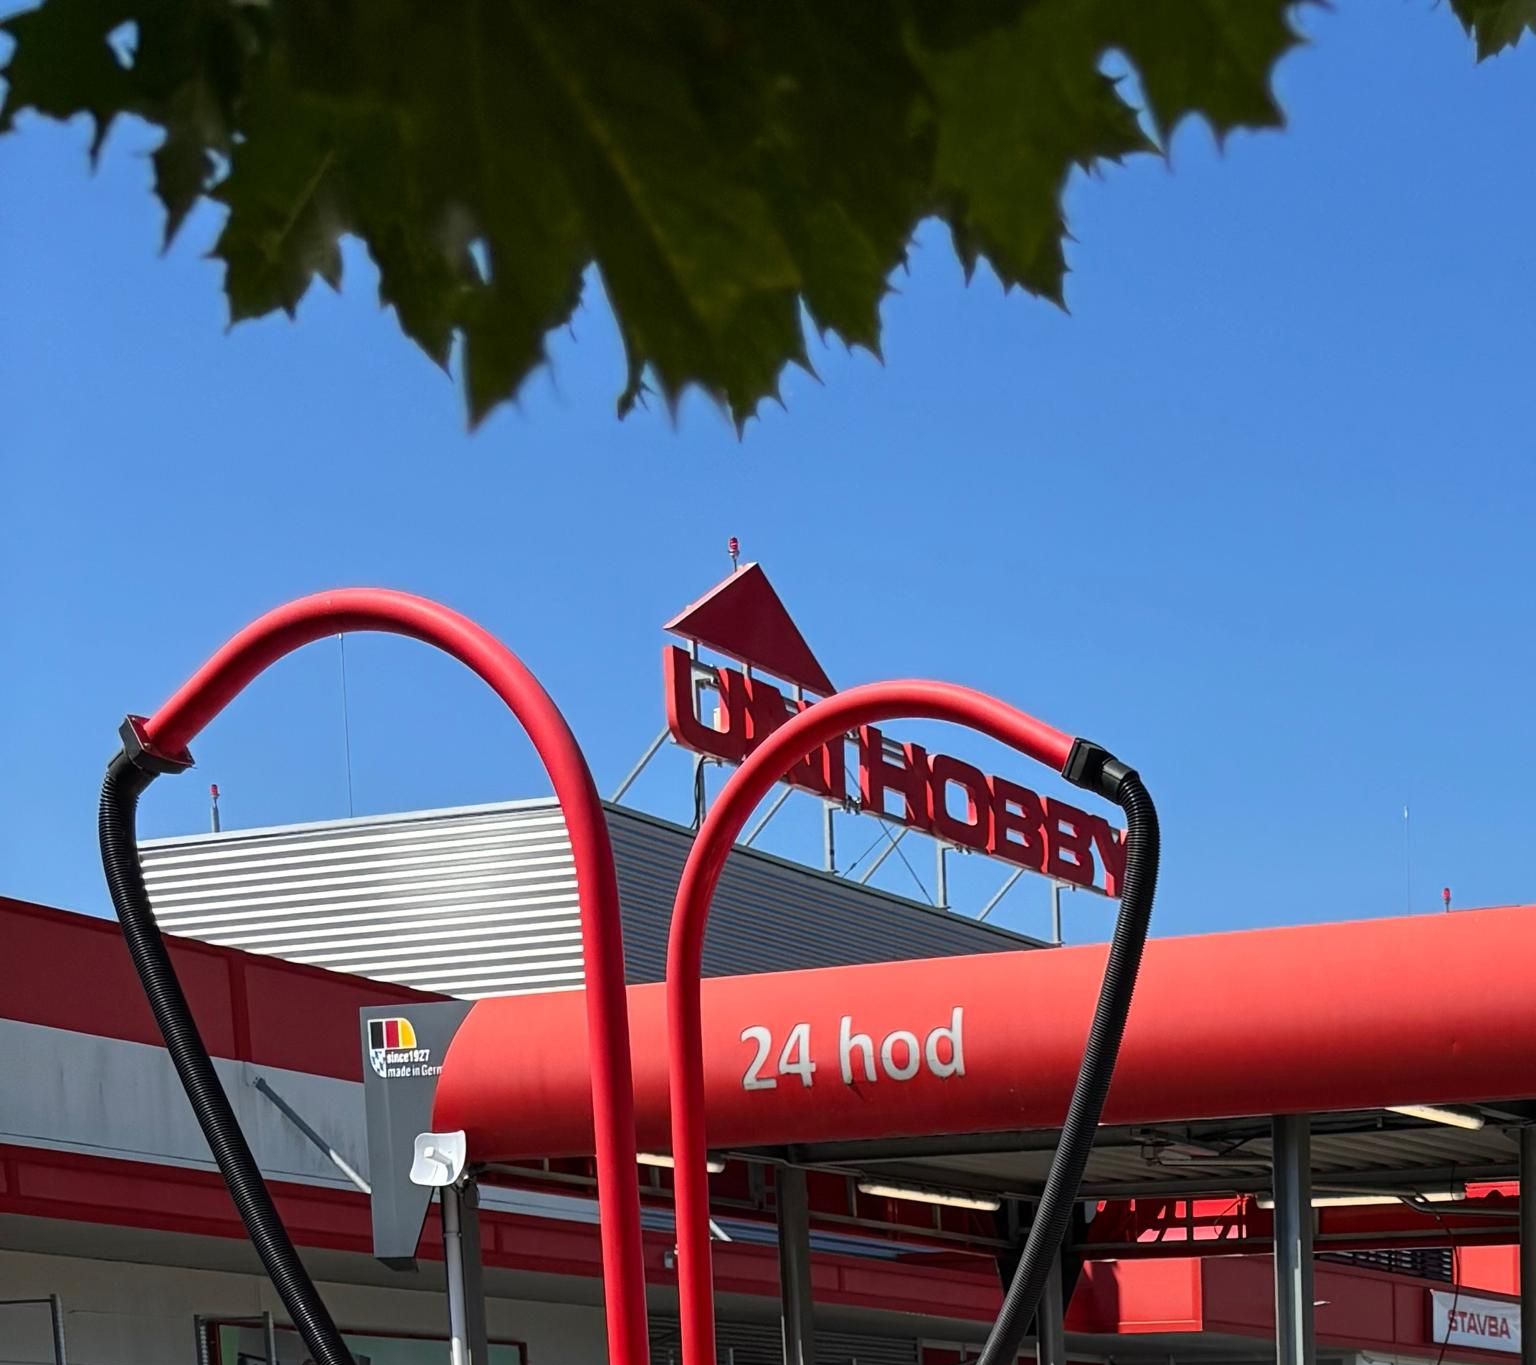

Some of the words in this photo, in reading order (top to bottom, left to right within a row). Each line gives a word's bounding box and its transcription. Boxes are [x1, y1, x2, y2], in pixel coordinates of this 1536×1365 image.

[740, 1023, 815, 1090] 24
[839, 1006, 965, 1086] hod
[388, 1065, 411, 1077] made
[412, 1065, 420, 1076] in
[1447, 1309, 1511, 1339] STAVBA
